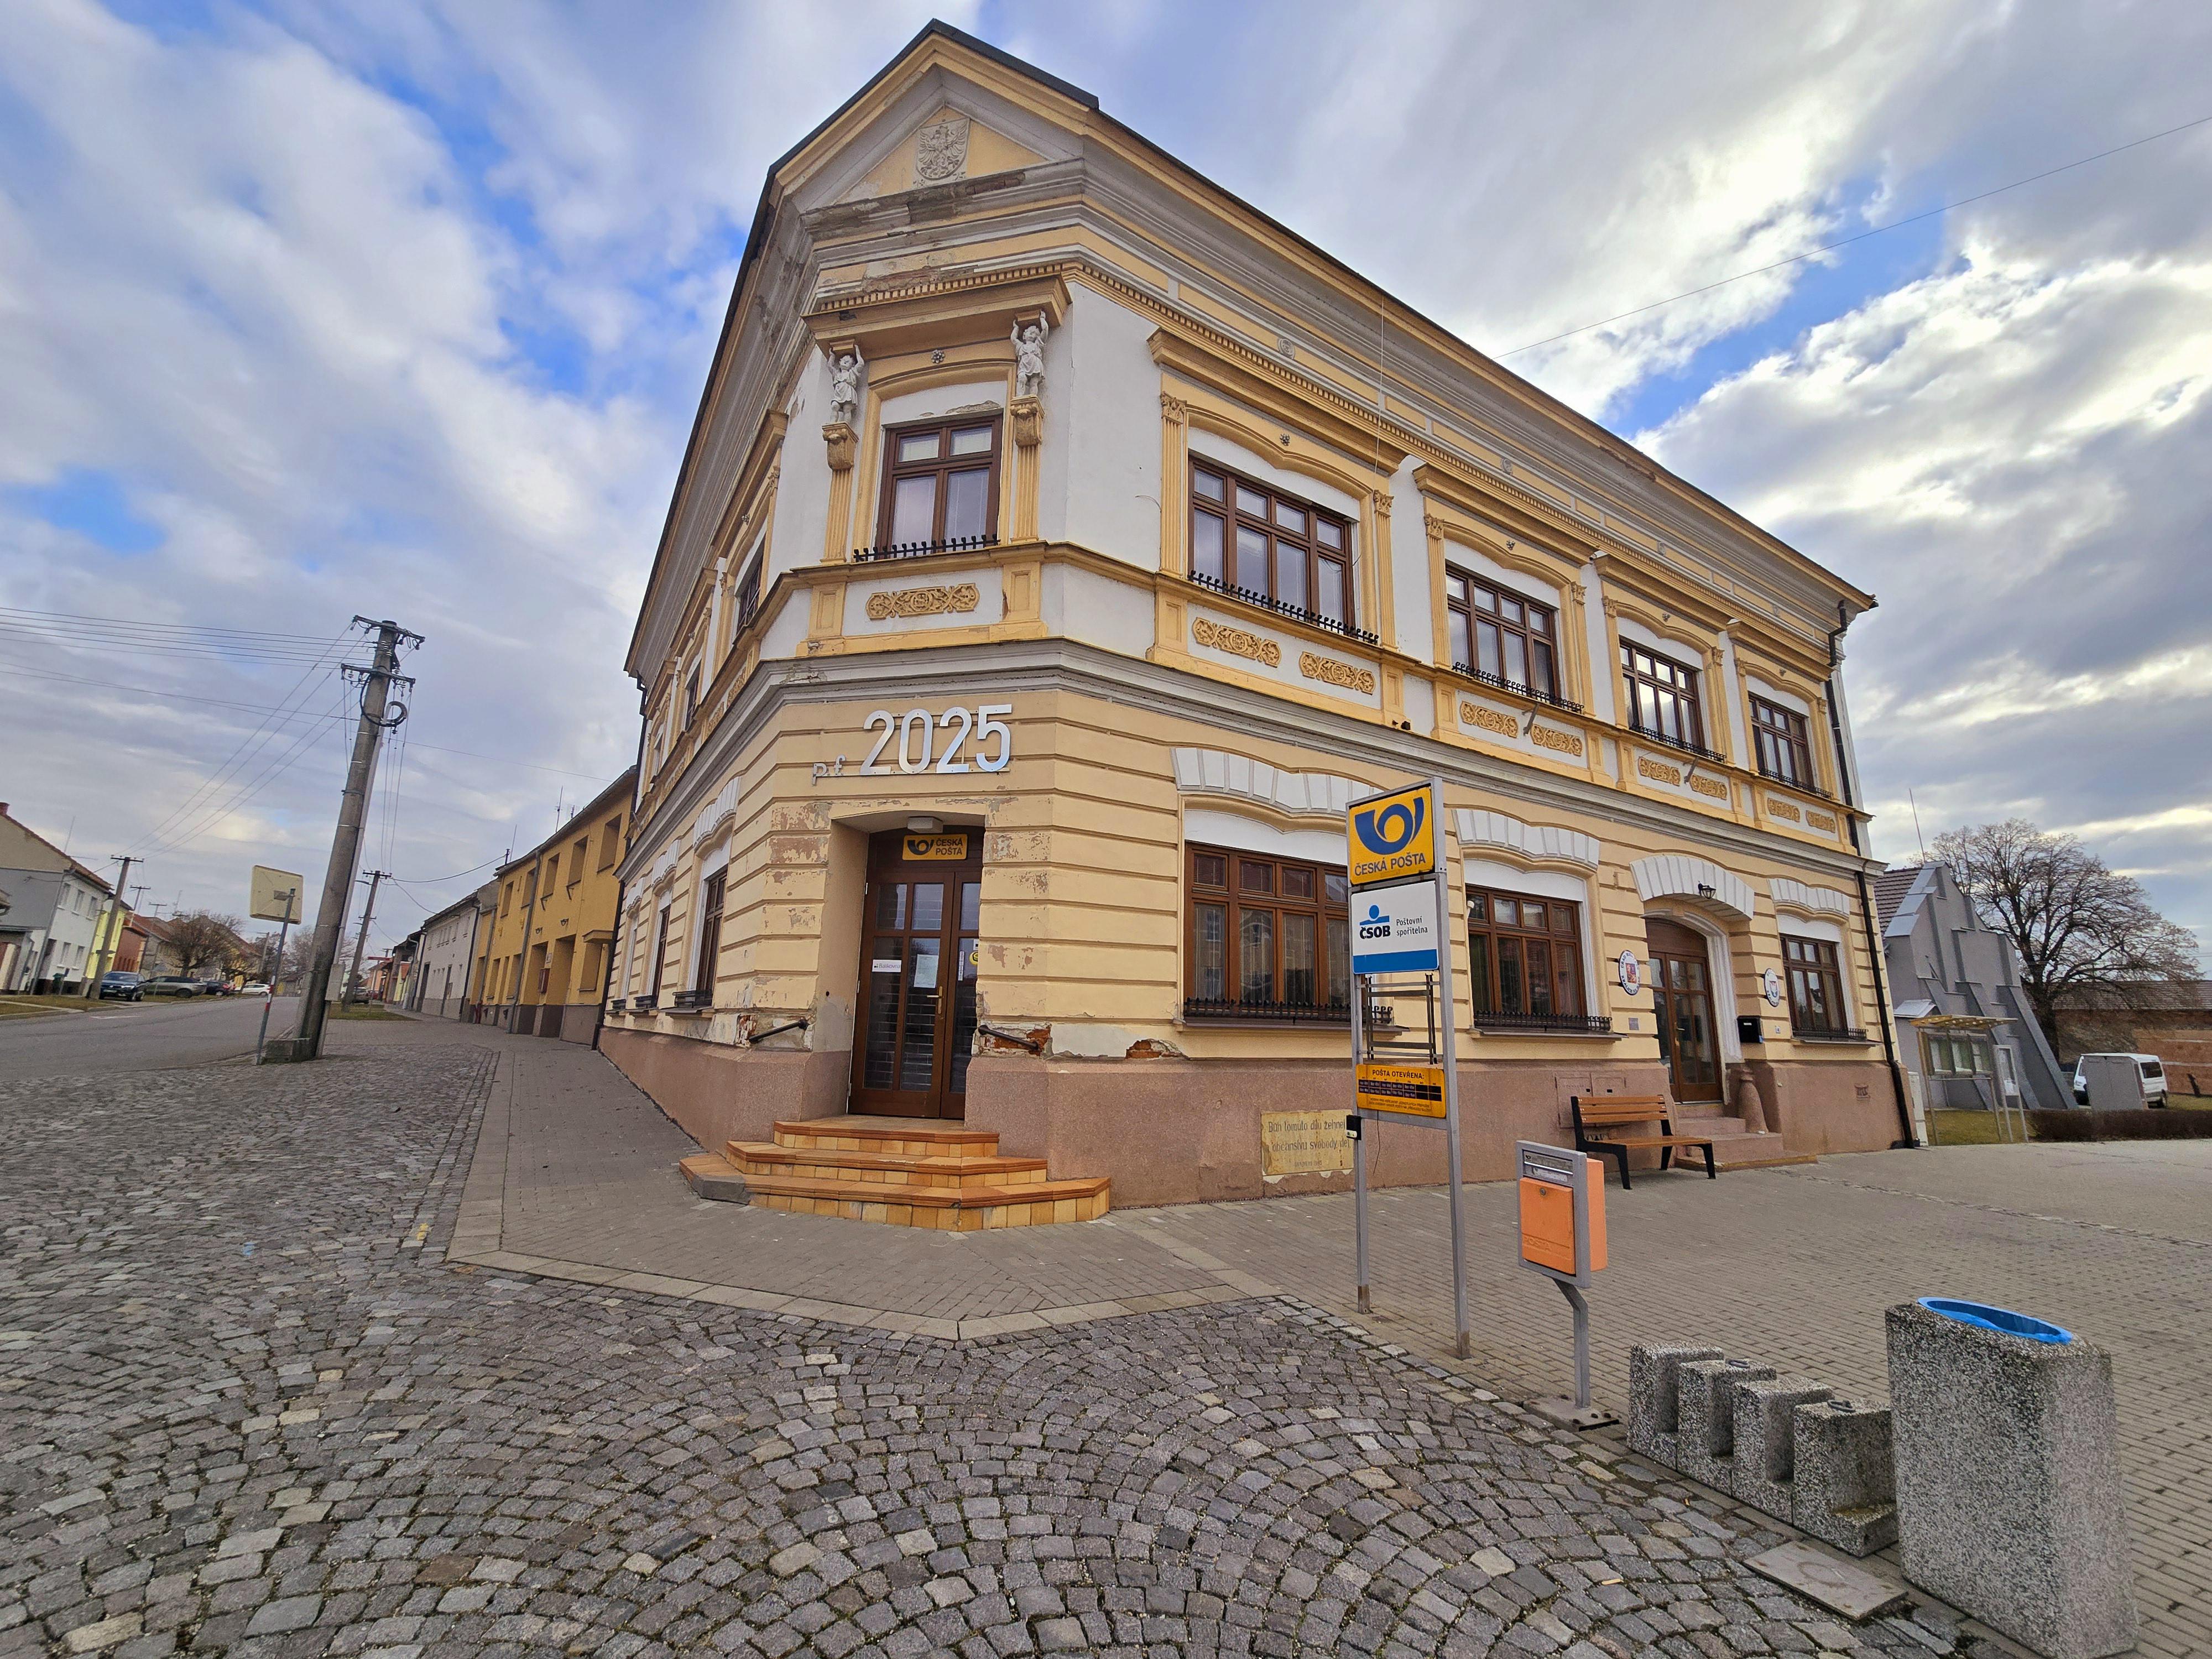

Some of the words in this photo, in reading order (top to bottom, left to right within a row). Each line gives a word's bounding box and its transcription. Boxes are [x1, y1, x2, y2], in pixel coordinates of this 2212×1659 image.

[860, 704, 1012, 774] 2025
[936, 837, 963, 846] ČESKÁ
[936, 847, 962, 855] POŠTA
[1354, 857, 1387, 877] ČESKÁ
[1391, 852, 1426, 870] POŠTA
[1396, 915, 1422, 926] Poštovní
[1359, 925, 1391, 939] ČSOB
[1396, 926, 1428, 937] spořitelna
[1372, 1068, 1390, 1077] POŠTA
[1391, 1071, 1425, 1079] OTEVŘENA:
